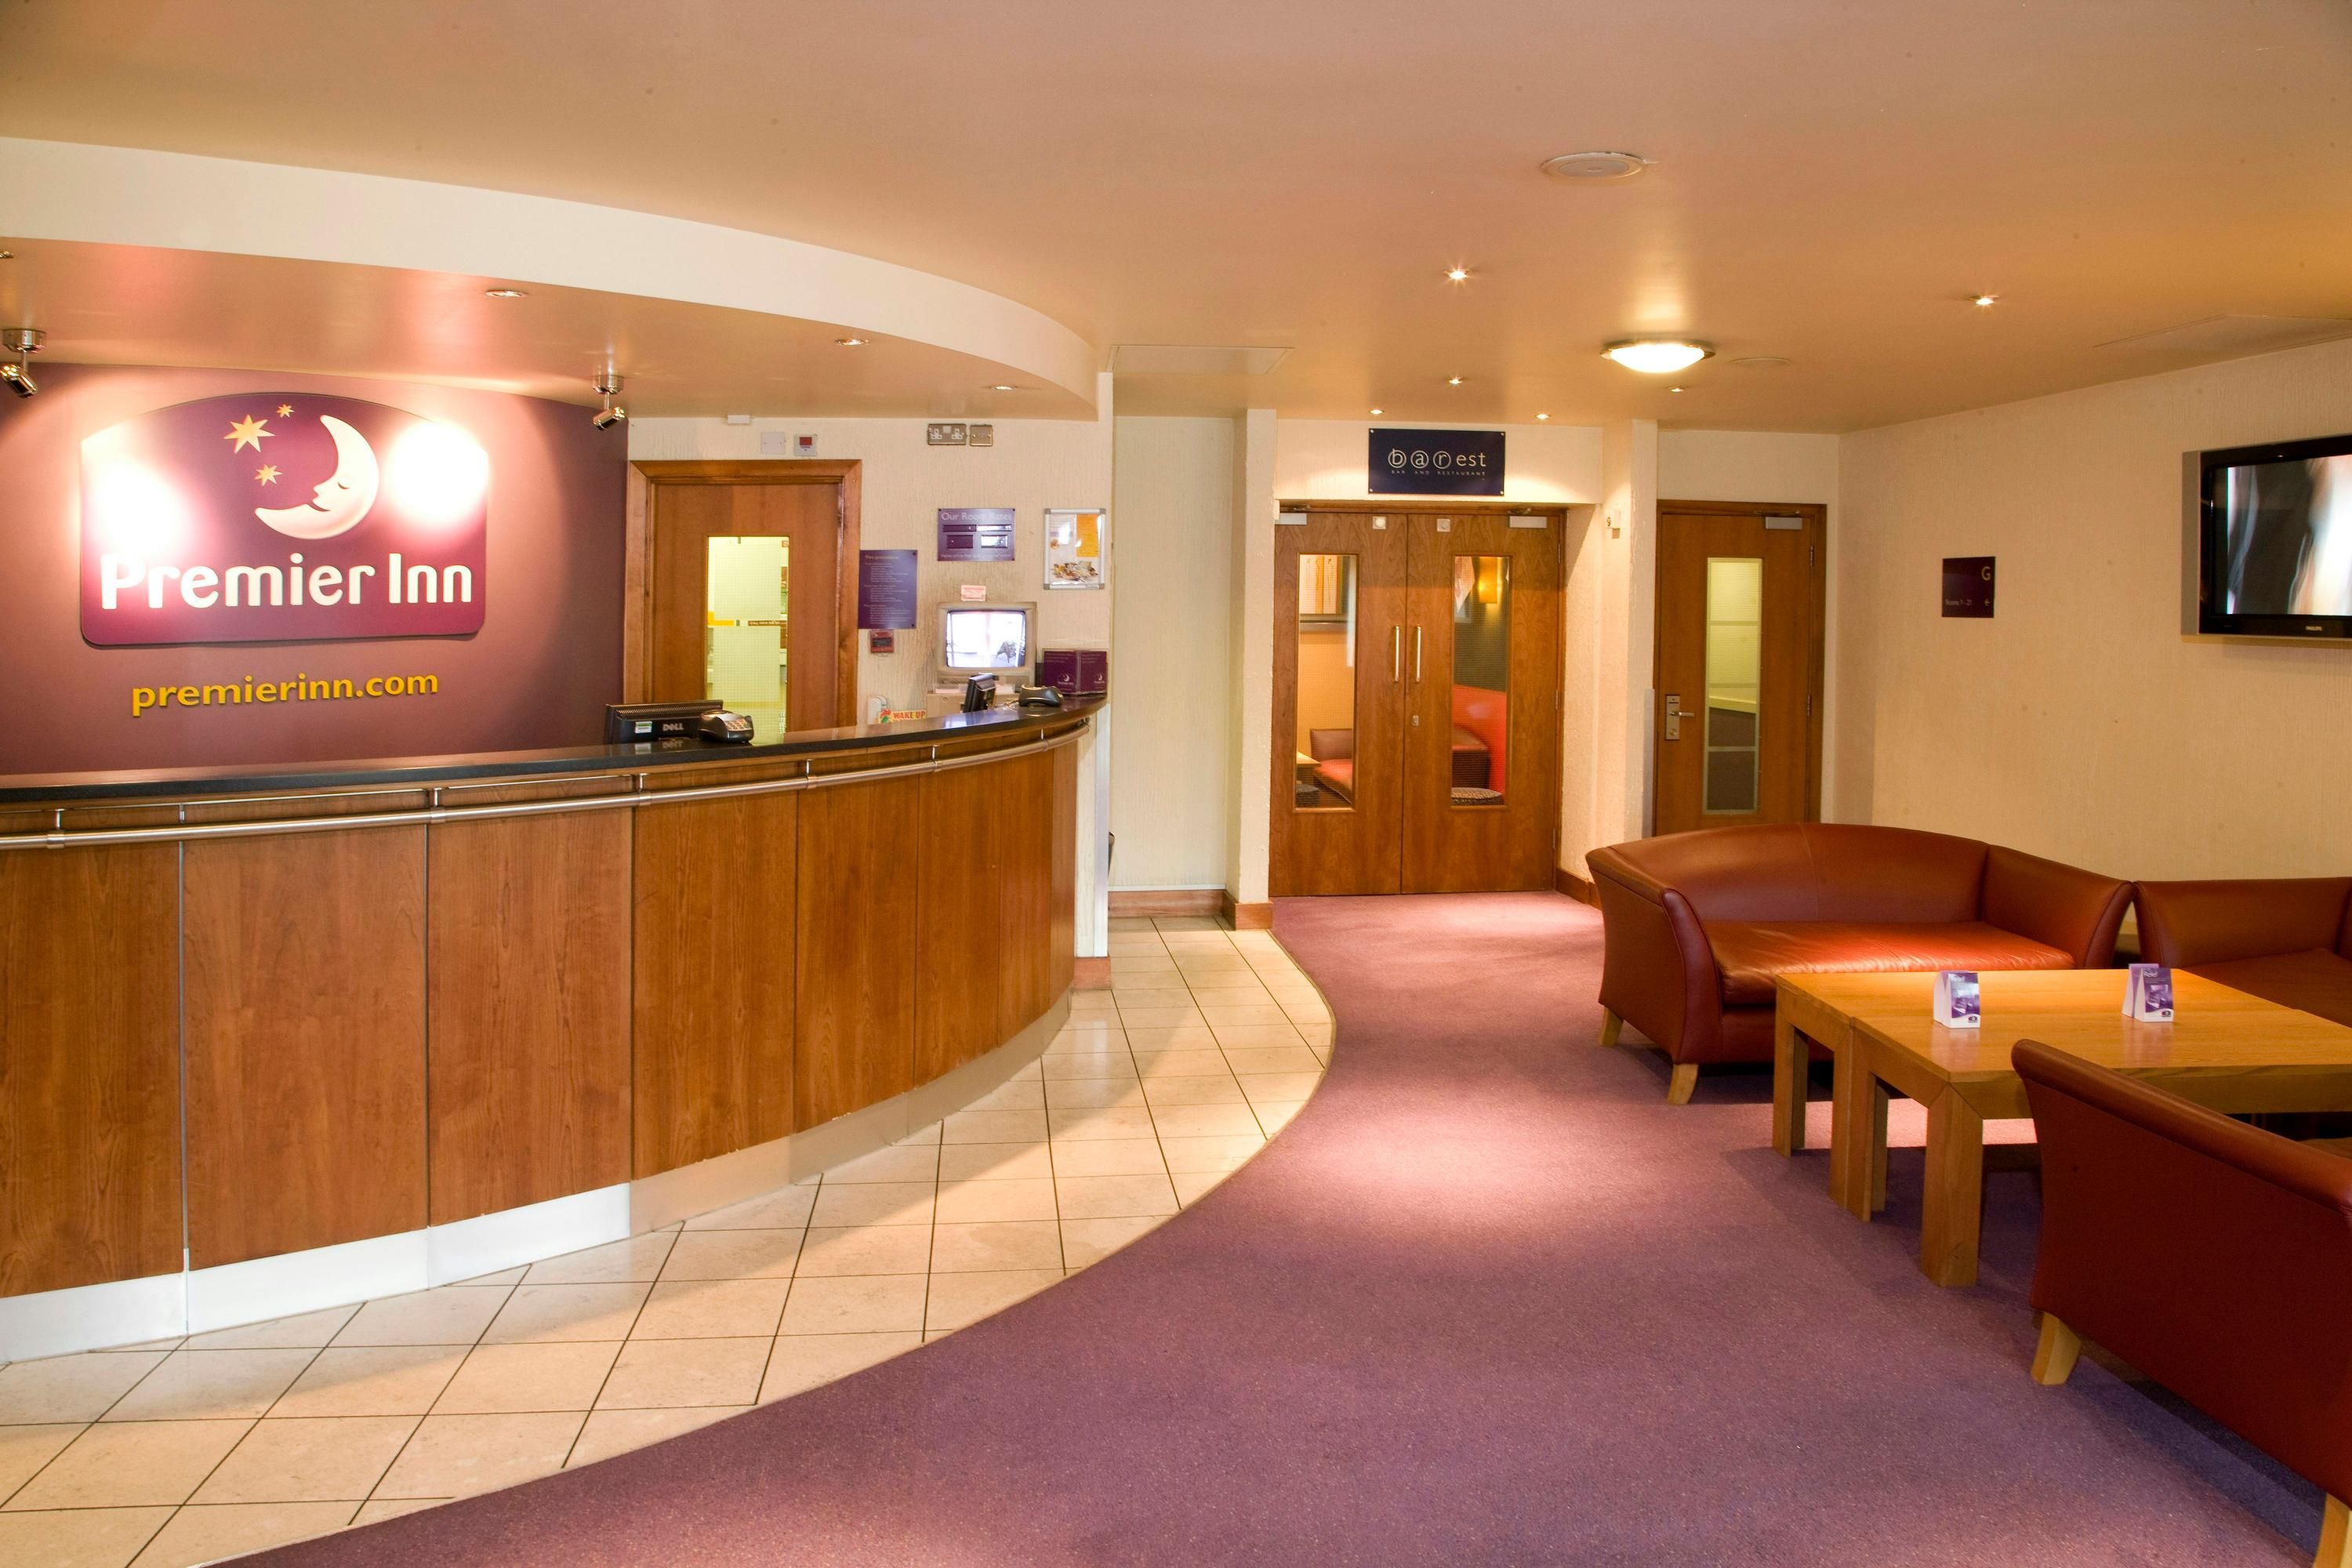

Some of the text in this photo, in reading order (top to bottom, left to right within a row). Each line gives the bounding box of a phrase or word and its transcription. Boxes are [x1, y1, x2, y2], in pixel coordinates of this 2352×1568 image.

[942, 512, 959, 521] Our
[1981, 566, 1991, 580] G
[100, 552, 472, 610] Premier Inn
[132, 673, 438, 717] premierinn.com
[662, 723, 684, 731] DELL
